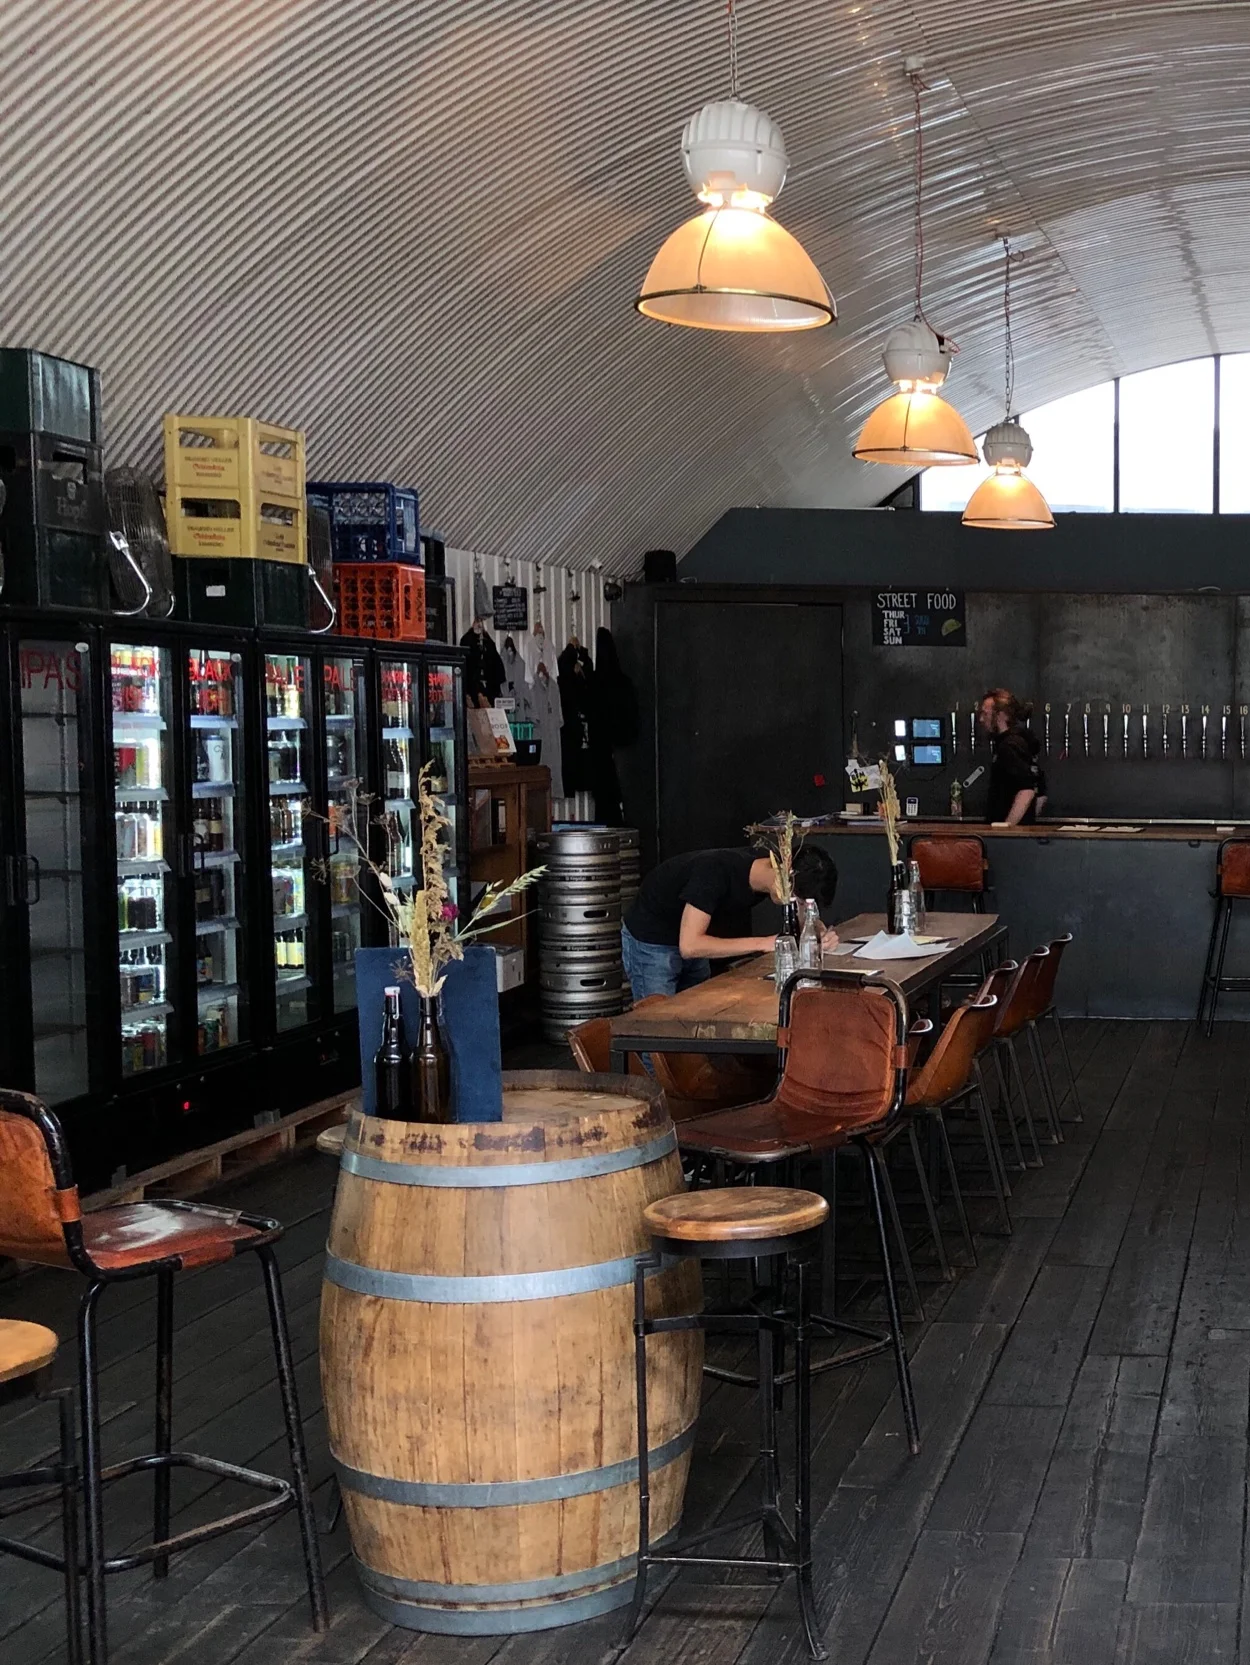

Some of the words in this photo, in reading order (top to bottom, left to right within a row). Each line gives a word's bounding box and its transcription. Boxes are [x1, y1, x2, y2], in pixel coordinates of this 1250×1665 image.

[877, 593, 917, 608] STREET
[927, 593, 957, 610] FOOD
[882, 610, 905, 619] THUR
[883, 619, 898, 628] FRI
[883, 628, 901, 636] SAT
[883, 636, 902, 645] SUN
[265, 662, 304, 693] PALE
[1122, 704, 1132, 714] 10
[1143, 704, 1149, 714] 11
[1162, 704, 1170, 714] 12
[1181, 704, 1190, 714] 13
[1201, 705, 1210, 714] 14
[1223, 705, 1231, 714] 15
[1240, 706, 1248, 714] 16
